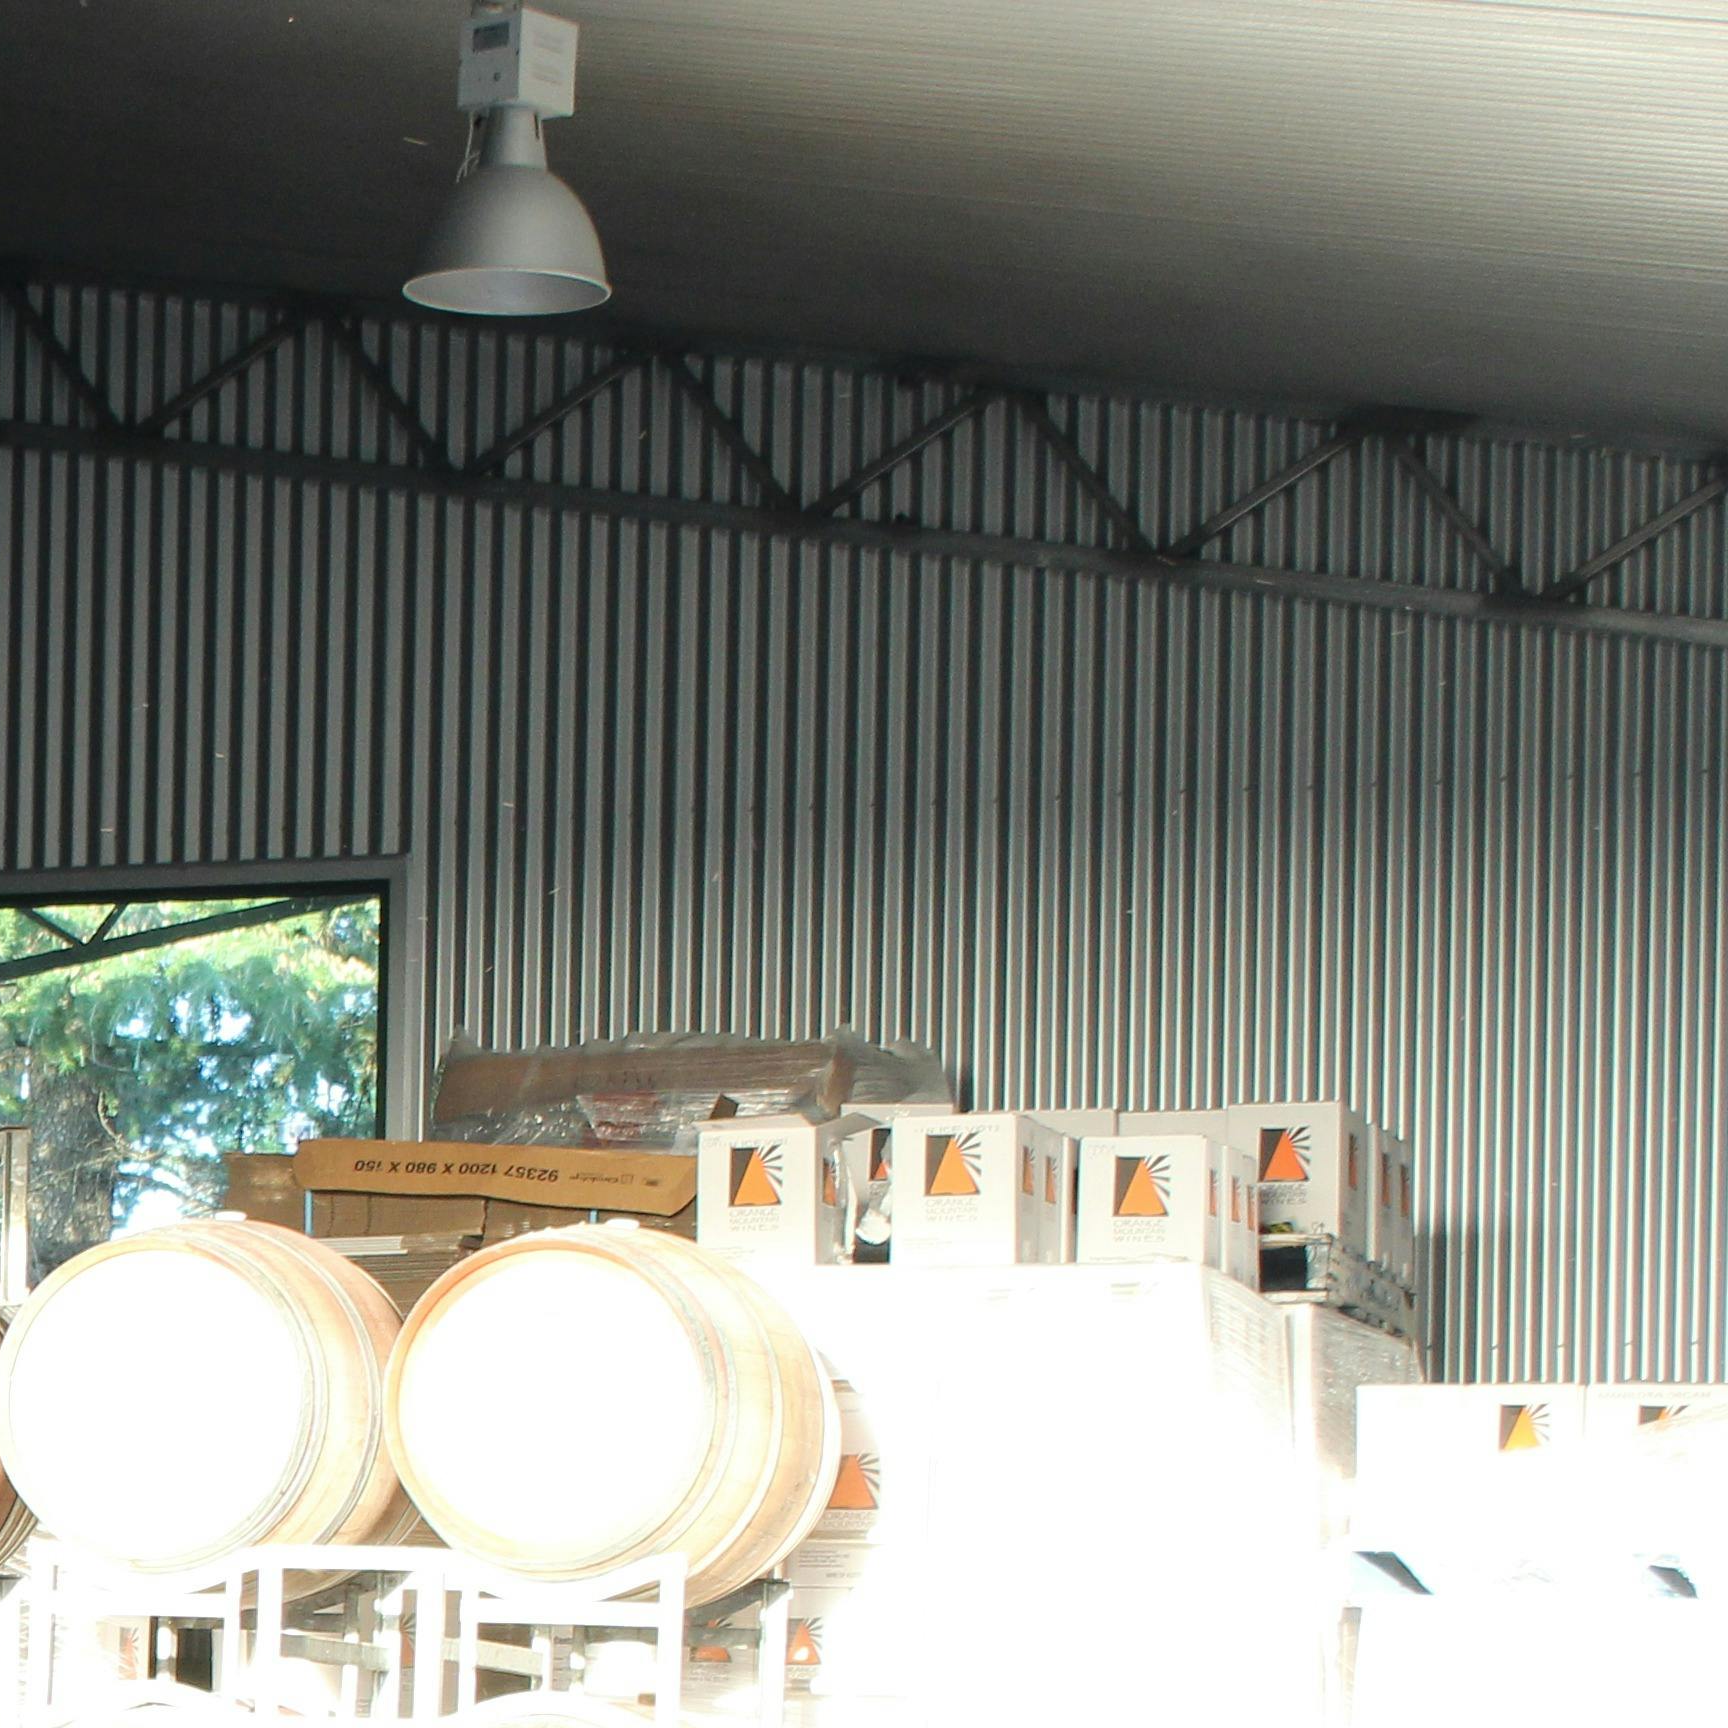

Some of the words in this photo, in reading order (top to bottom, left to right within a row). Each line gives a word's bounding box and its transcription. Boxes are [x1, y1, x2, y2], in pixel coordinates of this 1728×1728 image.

[389, 1161, 400, 1173] X
[406, 1161, 437, 1174] 980
[443, 1162, 453, 1175] X
[459, 1162, 496, 1175] 1200
[504, 1165, 559, 1182] 92357
